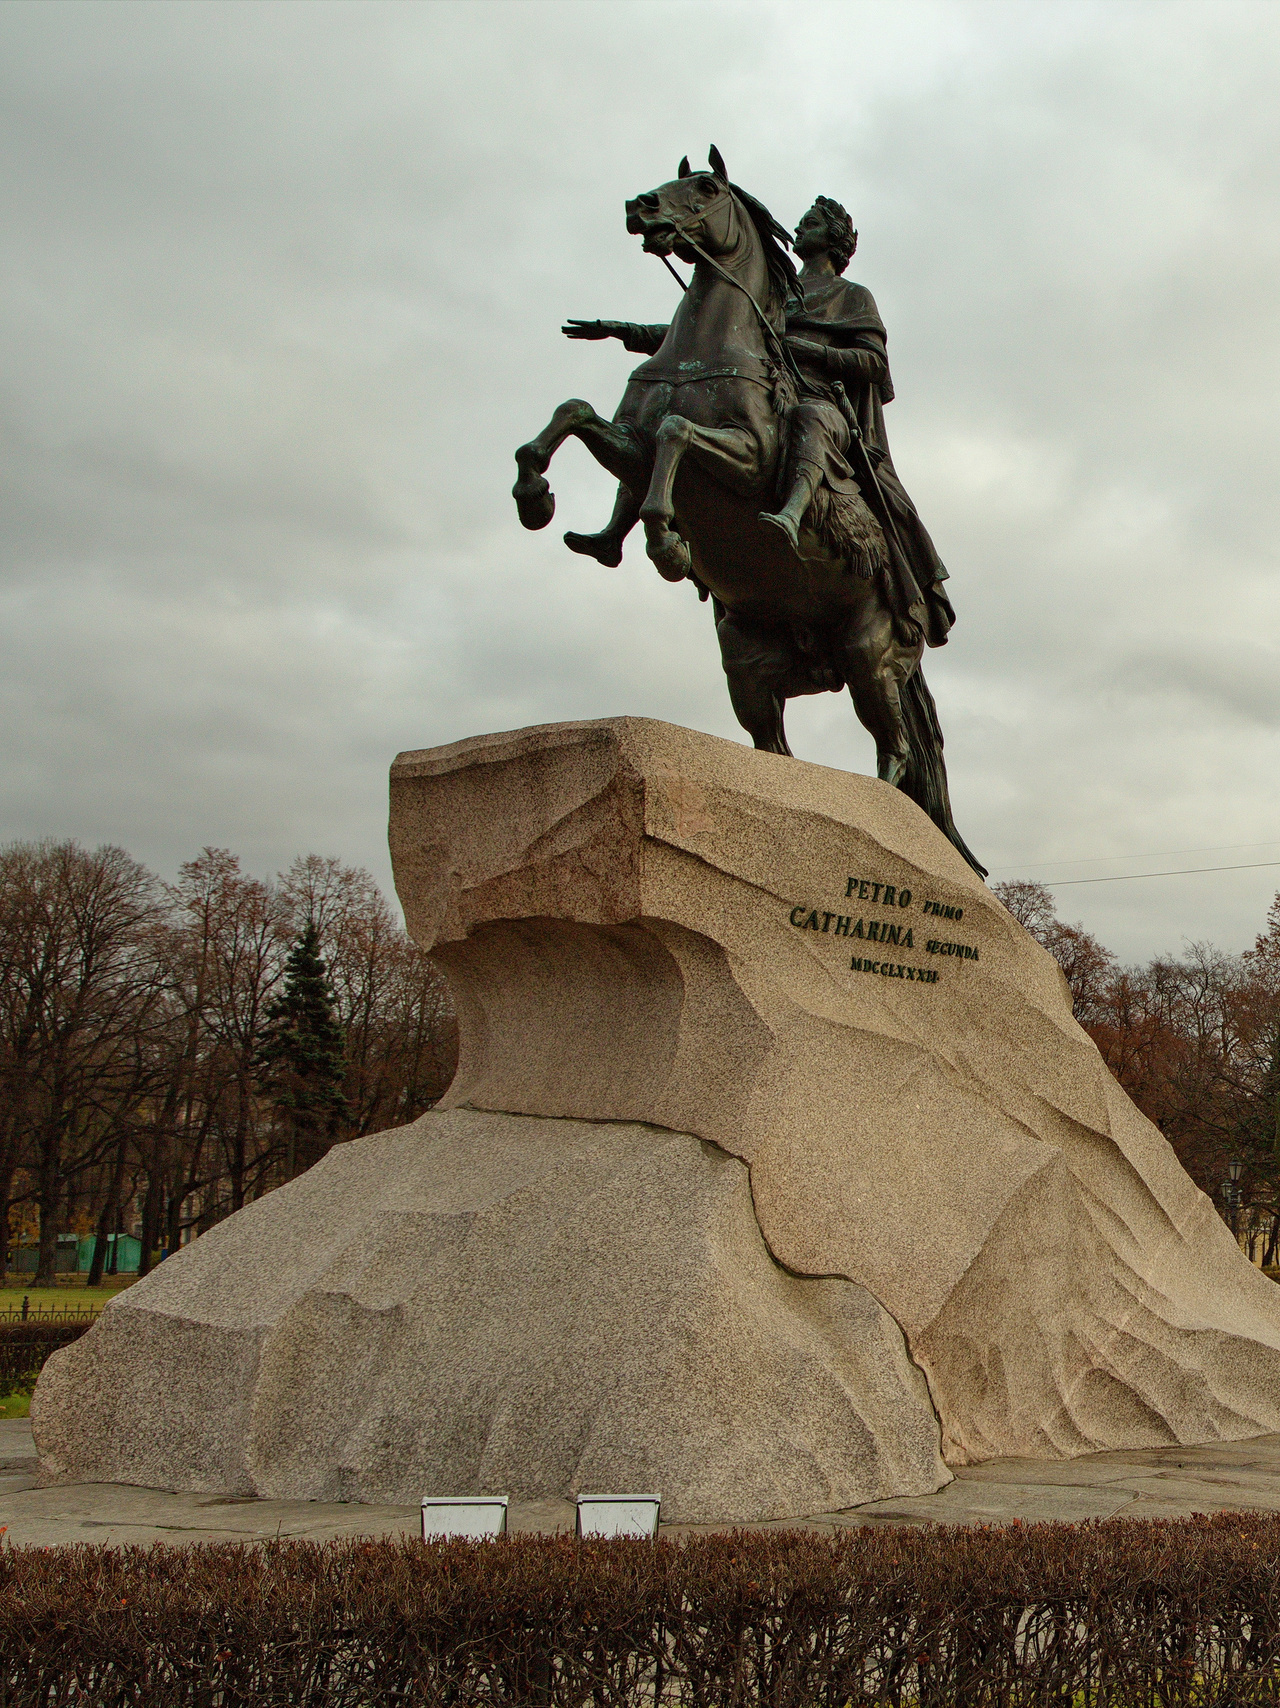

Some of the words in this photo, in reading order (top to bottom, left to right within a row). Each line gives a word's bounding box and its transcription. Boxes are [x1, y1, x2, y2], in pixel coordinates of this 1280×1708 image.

[845, 877, 912, 908] PETRO
[923, 900, 964, 921] PRIMO
[790, 906, 914, 948] CATHARINA
[925, 940, 980, 961] SECUNDA
